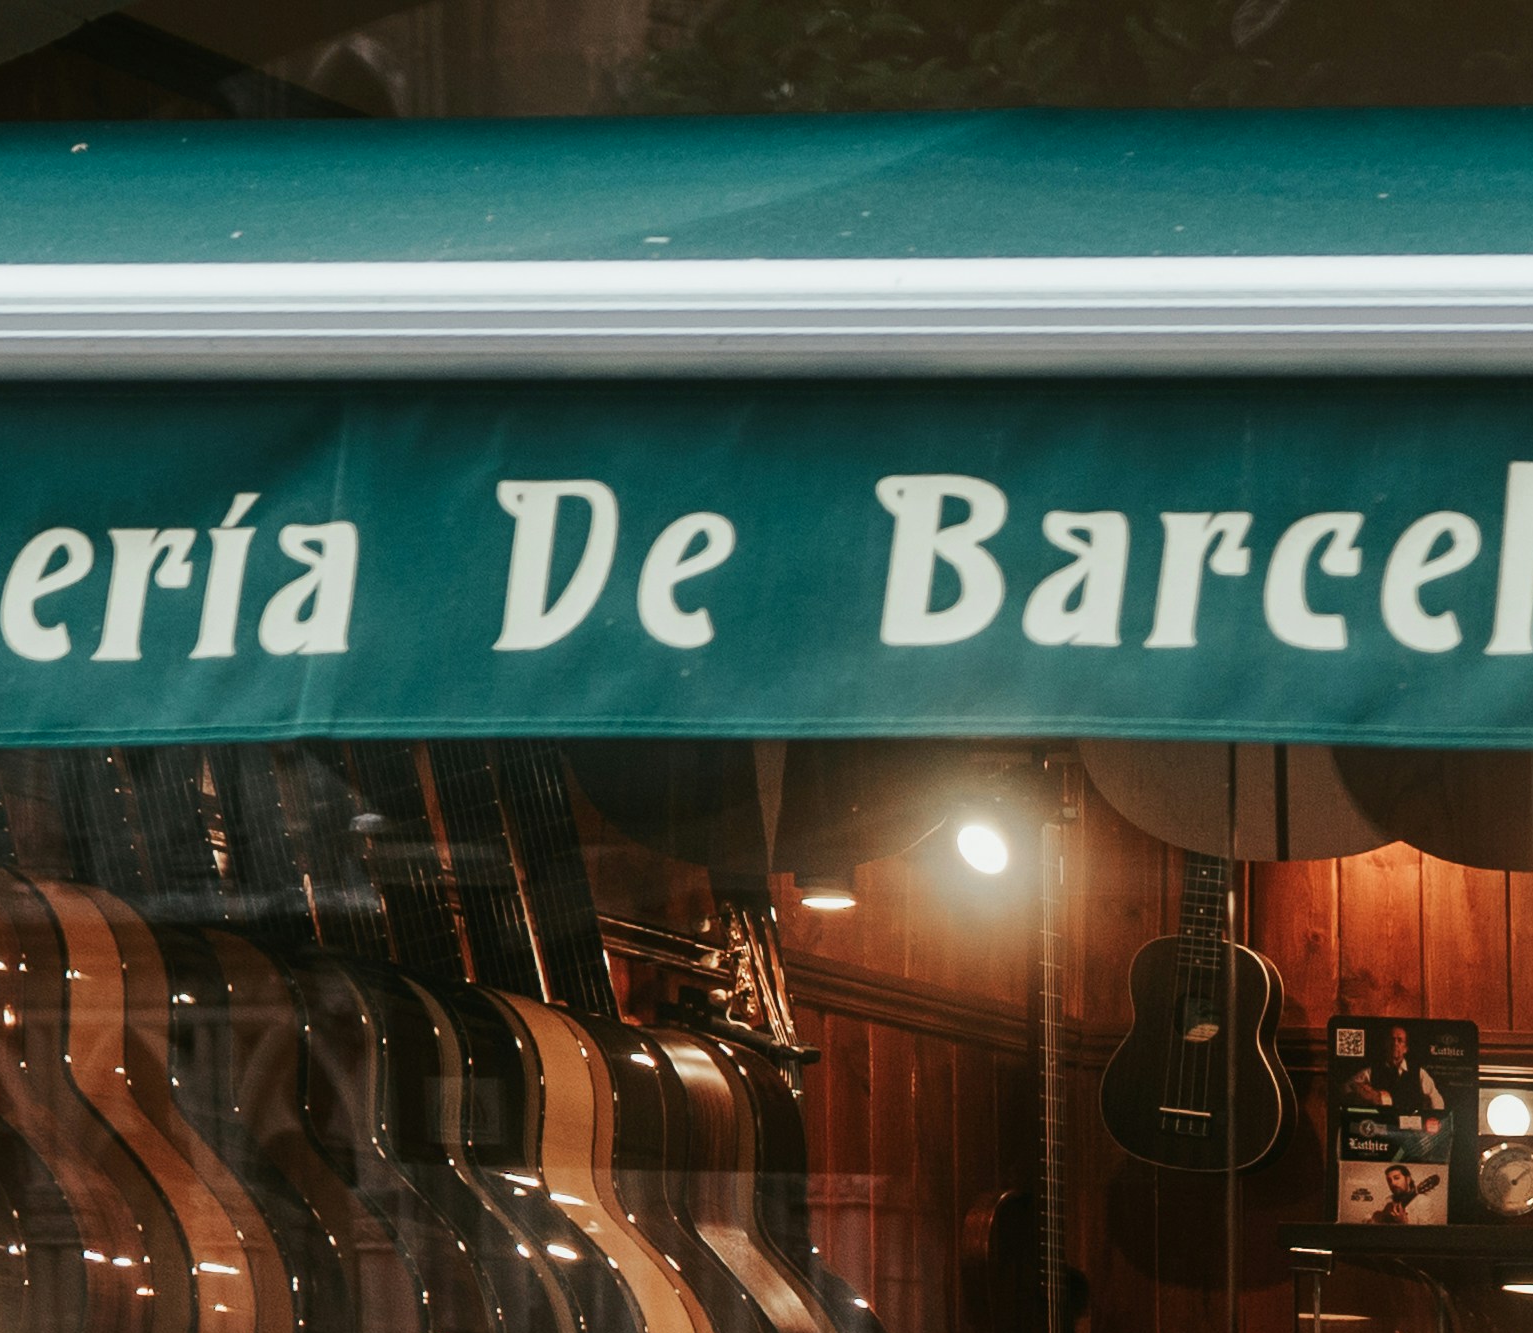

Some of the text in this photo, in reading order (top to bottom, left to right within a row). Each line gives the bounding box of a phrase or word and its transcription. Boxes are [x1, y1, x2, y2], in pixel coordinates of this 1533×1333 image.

[492, 479, 736, 651] De
[1429, 1044, 1465, 1057] Luthier
[1348, 1137, 1389, 1152] Luthier
